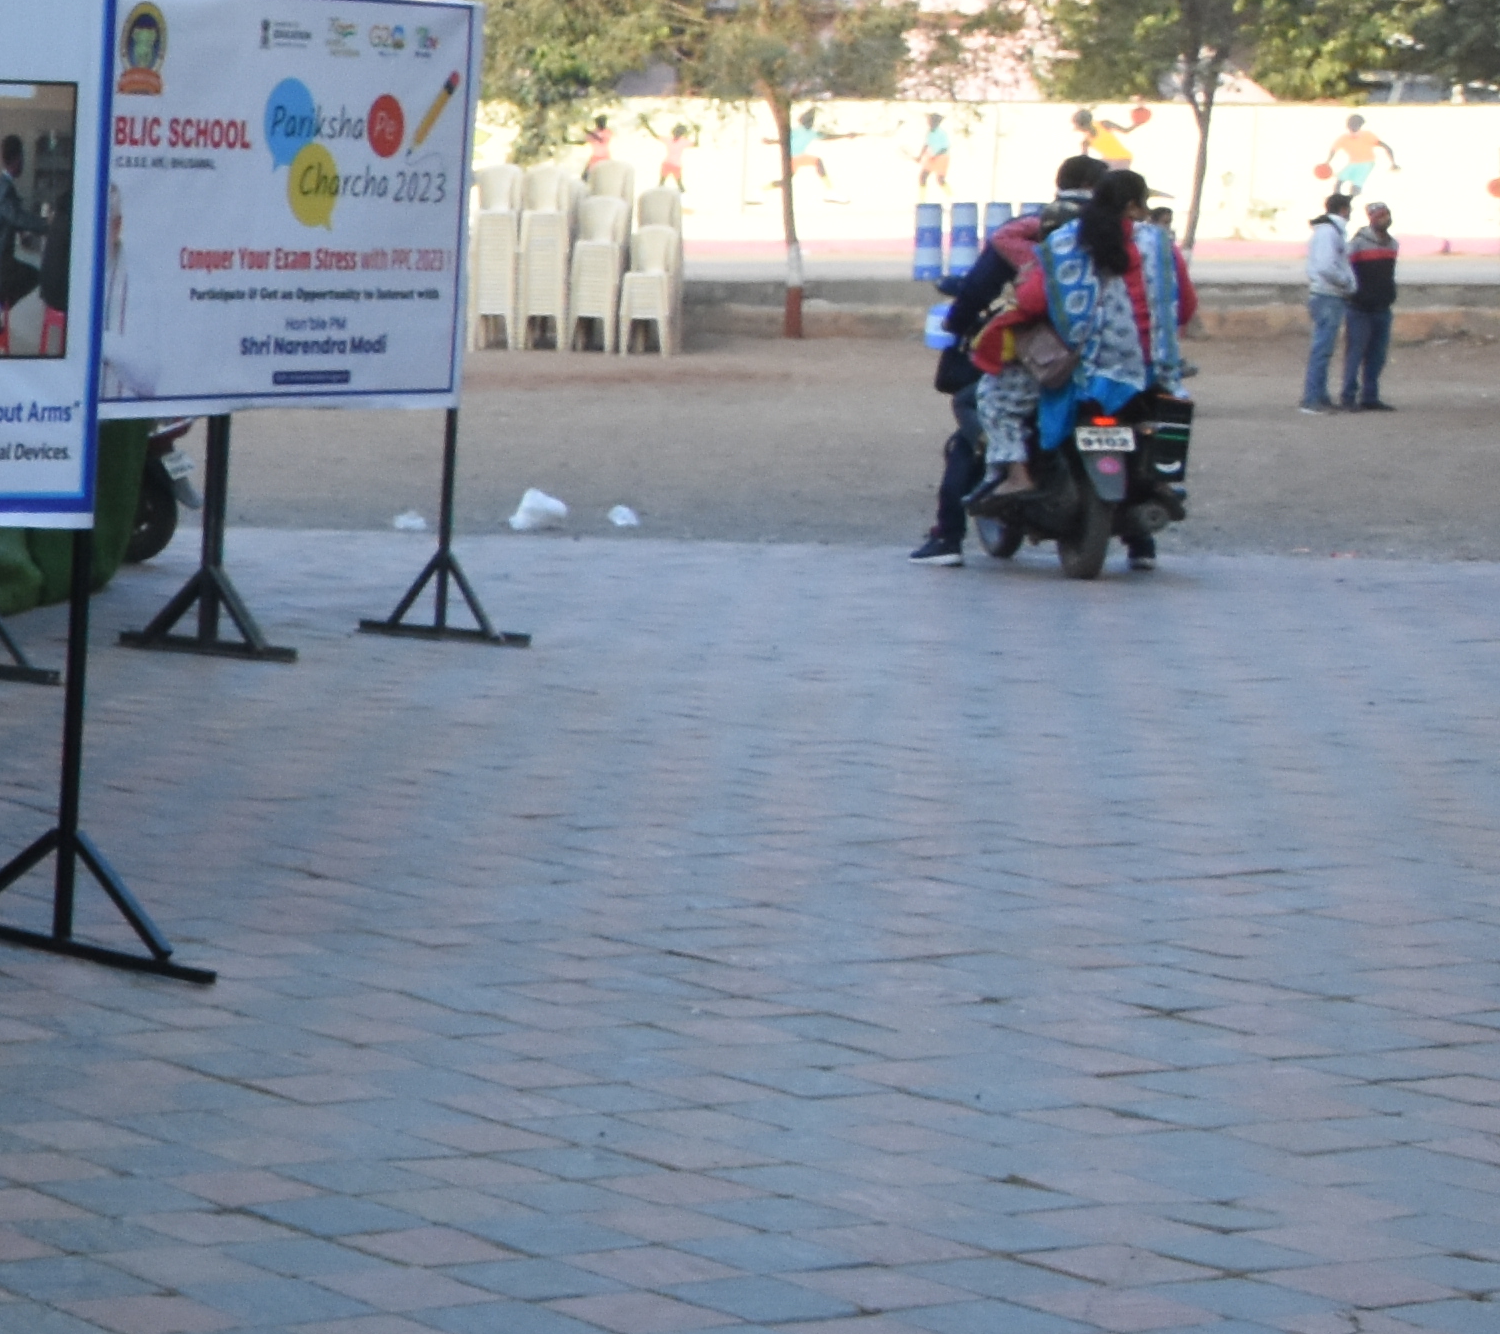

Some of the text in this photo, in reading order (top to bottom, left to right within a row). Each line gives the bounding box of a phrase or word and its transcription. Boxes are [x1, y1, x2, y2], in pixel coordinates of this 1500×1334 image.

[115, 116, 252, 150] BLIC SCHOOL
[271, 104, 395, 139] Pariksha Pe
[300, 161, 447, 204] Charcha 2023
[180, 247, 234, 273] Conquer
[239, 248, 270, 269] Your
[274, 248, 311, 270] Exam
[315, 248, 357, 270] Stress
[240, 334, 387, 356] Shri Narendra Modi
